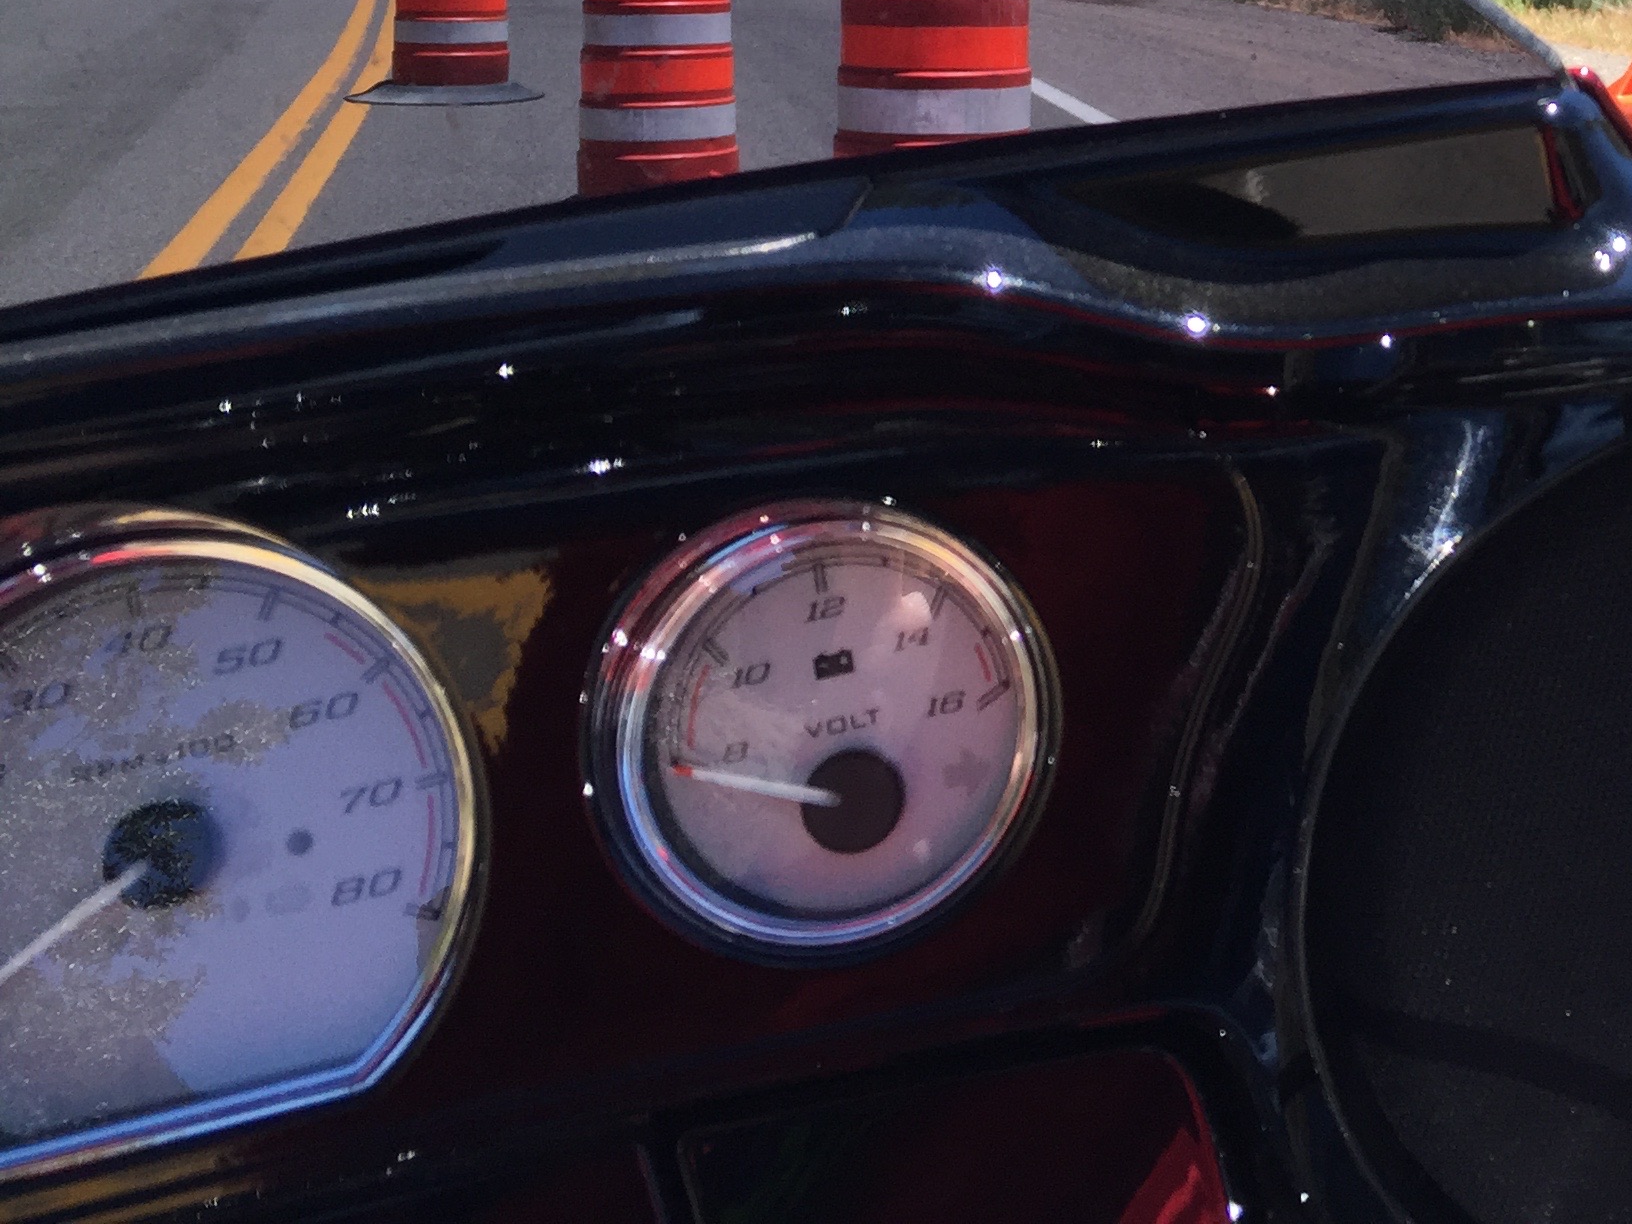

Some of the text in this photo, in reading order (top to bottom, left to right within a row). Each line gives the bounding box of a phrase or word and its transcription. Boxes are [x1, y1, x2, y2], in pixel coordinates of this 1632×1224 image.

[806, 596, 846, 623] 12
[894, 627, 930, 653] 14
[212, 637, 283, 675] 50
[731, 662, 771, 689] 10
[287, 690, 358, 731] 60
[927, 690, 966, 719] 16
[806, 709, 880, 739] VOLT
[722, 741, 749, 763] 8
[339, 779, 403, 816] 70
[330, 868, 404, 908] 80
